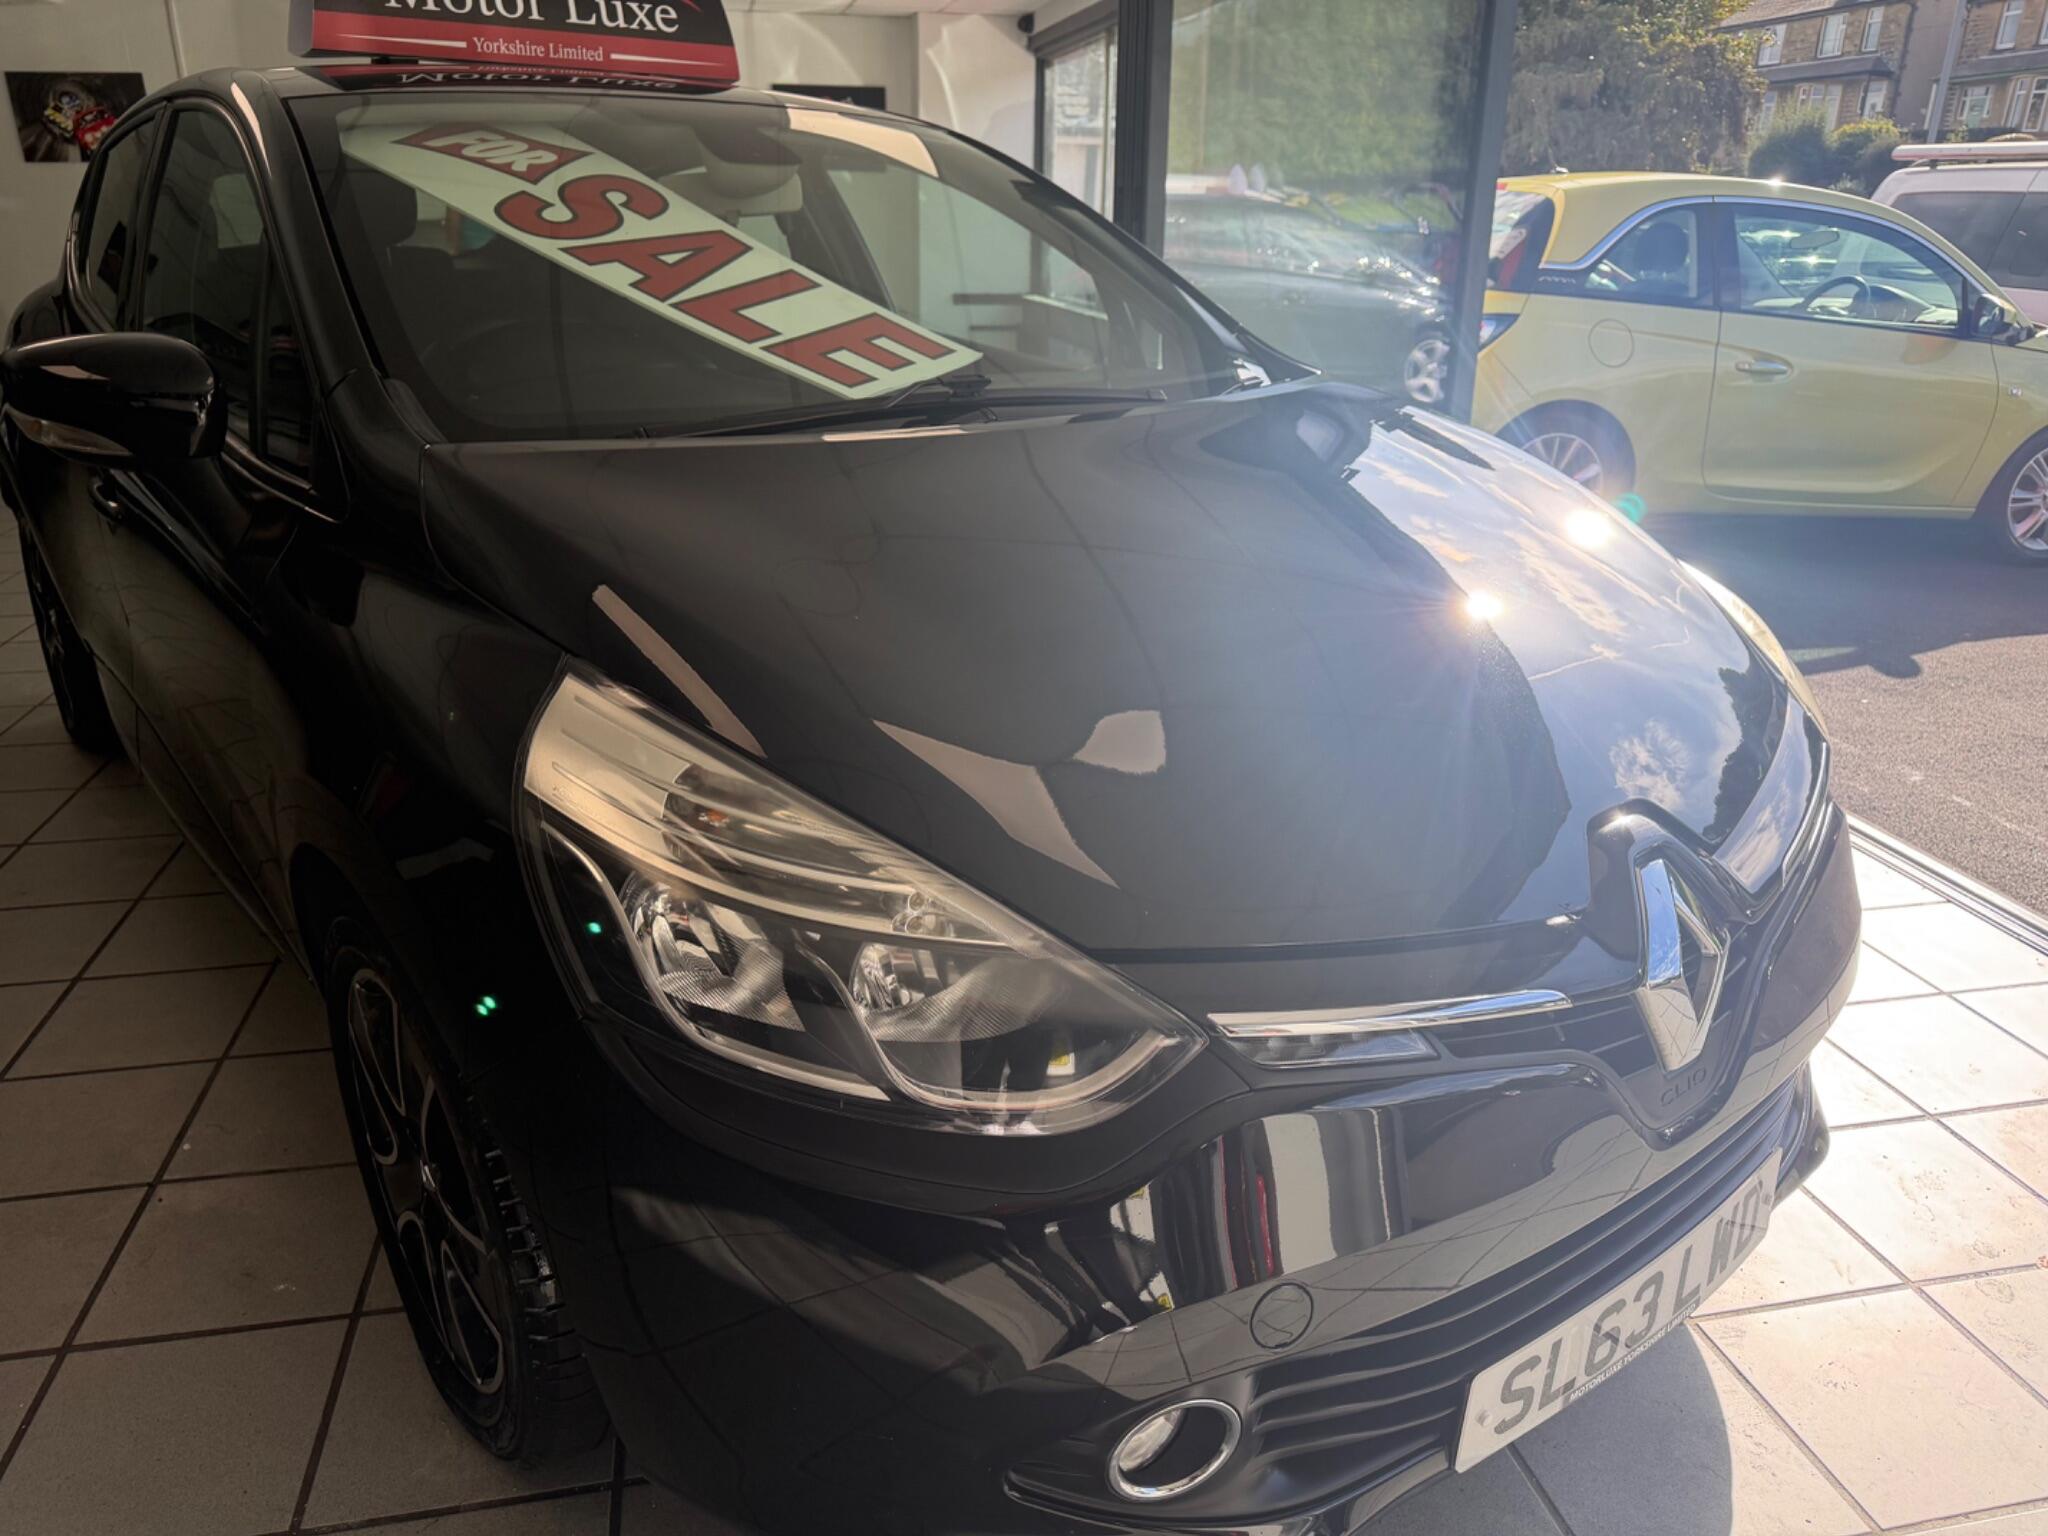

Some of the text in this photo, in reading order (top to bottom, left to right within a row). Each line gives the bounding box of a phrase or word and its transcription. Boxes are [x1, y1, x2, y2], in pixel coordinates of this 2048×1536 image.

[384, 0, 680, 33] otor Luxe
[473, 37, 604, 62] Yorkshire Limited
[422, 129, 559, 174] FOR
[493, 173, 958, 389] SALE
[1660, 1067, 1707, 1107] CLIO
[1493, 1269, 1665, 1435] SL63
